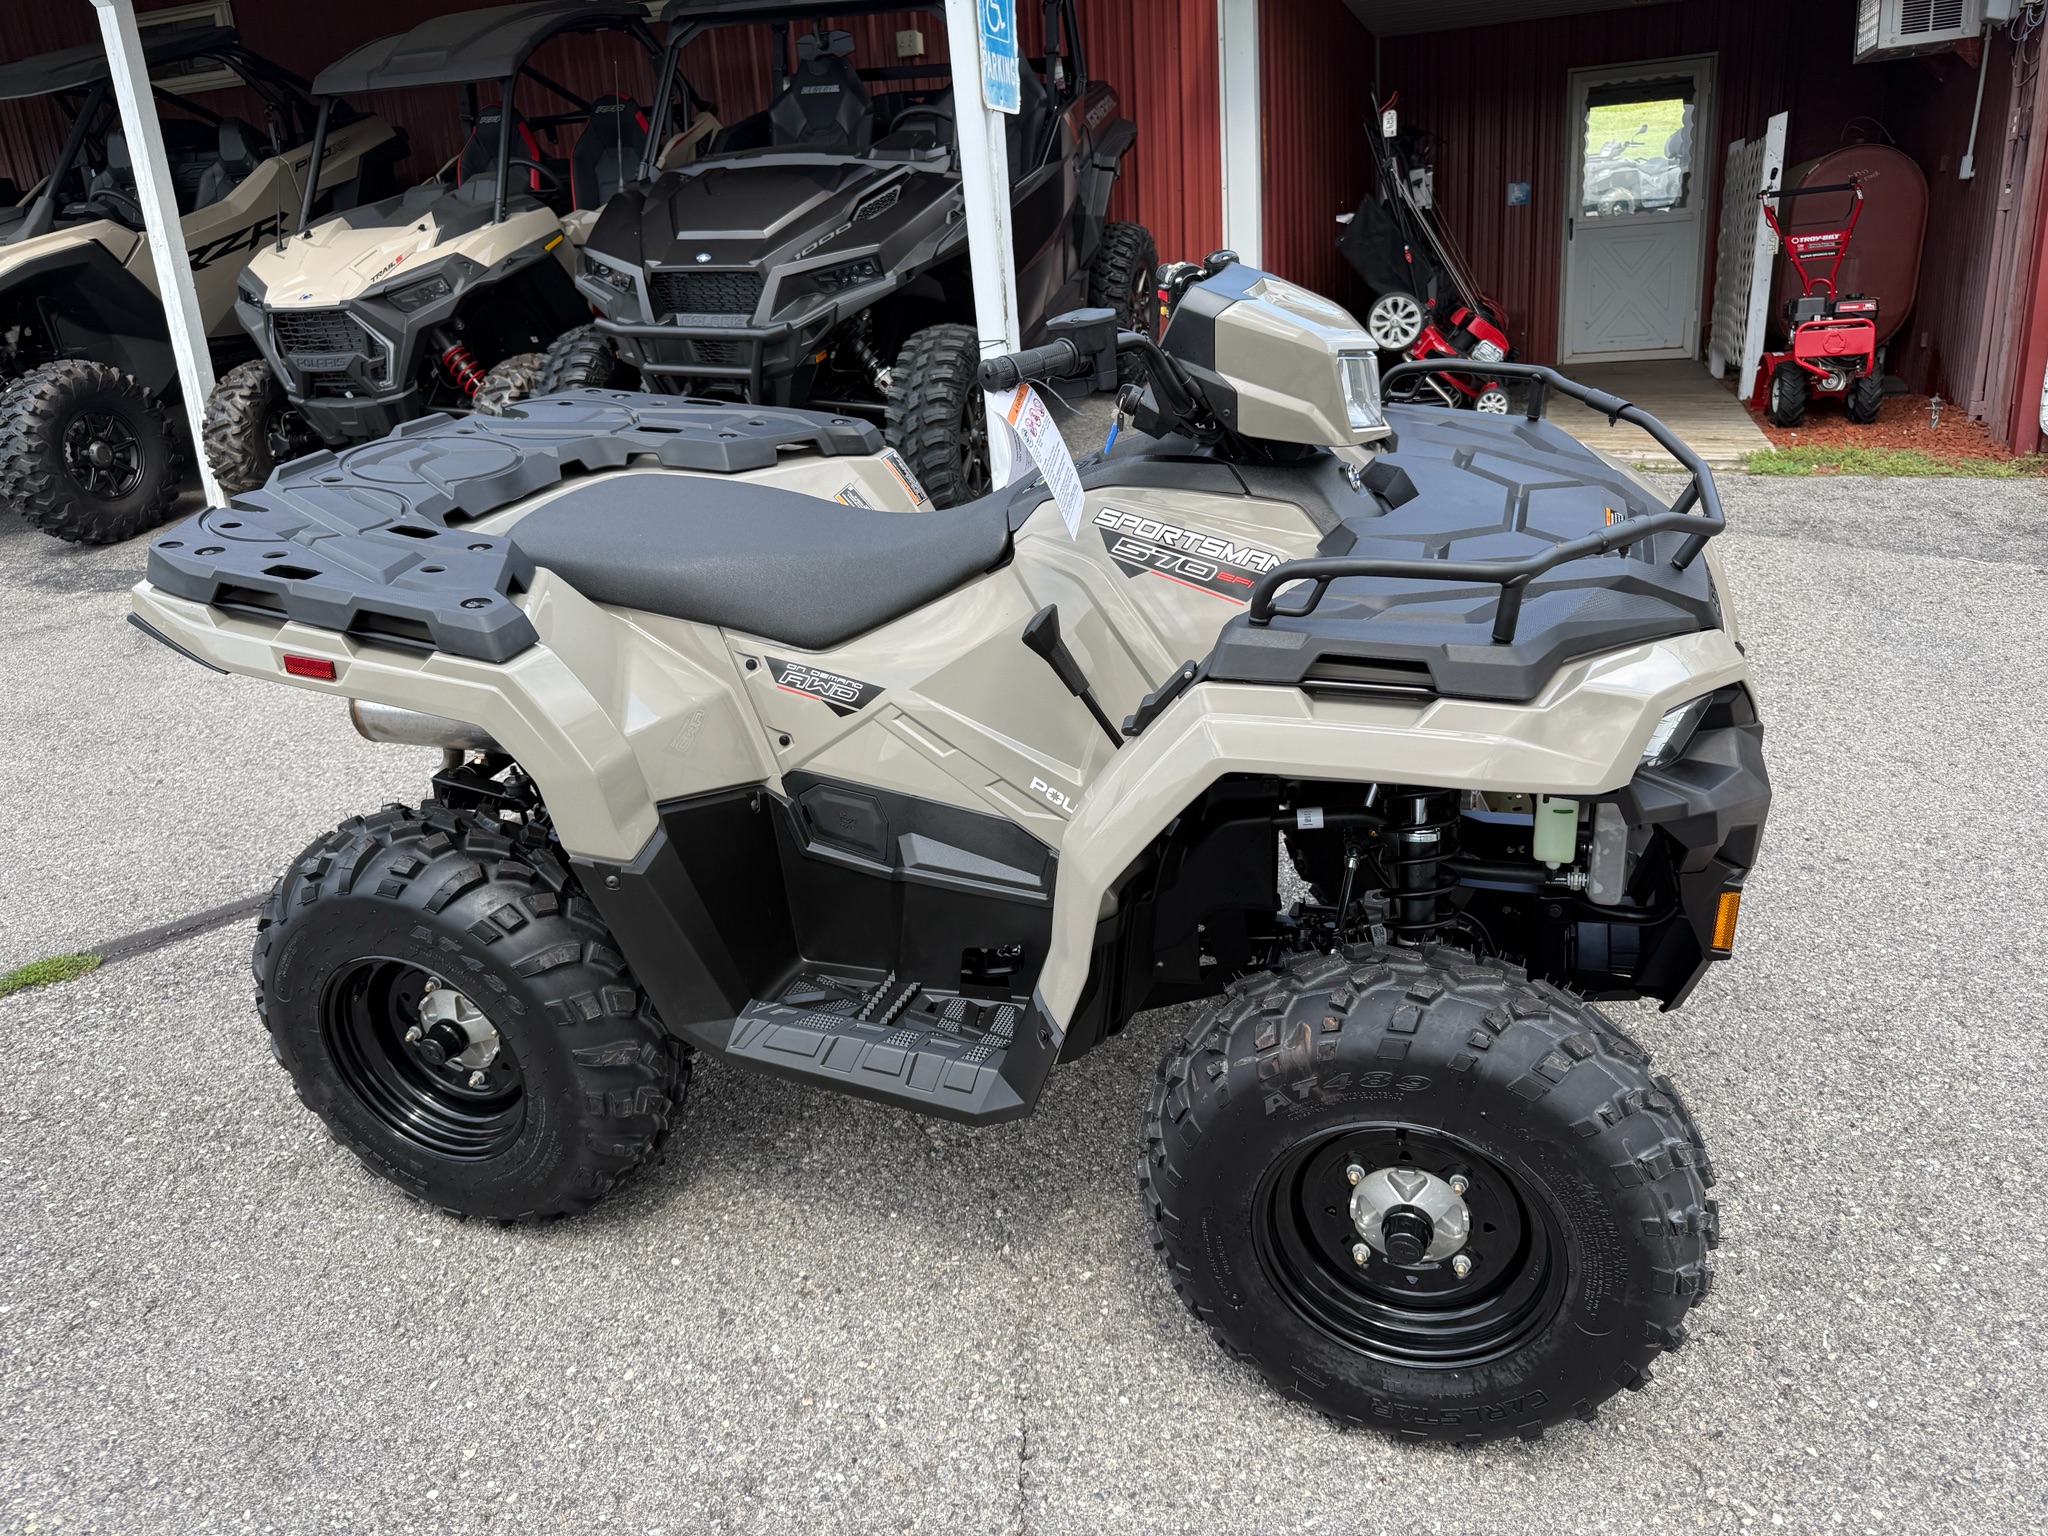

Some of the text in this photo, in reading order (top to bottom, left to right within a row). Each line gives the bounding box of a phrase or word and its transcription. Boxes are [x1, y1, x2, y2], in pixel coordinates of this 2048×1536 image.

[982, 50, 1019, 87] PARKING
[295, 147, 331, 173] PO
[794, 222, 852, 261] 1000
[370, 261, 396, 283] TRAIL
[681, 315, 745, 327] POLARIS
[297, 357, 346, 368] POLARIS
[1111, 537, 1255, 588] 570 EFI
[779, 670, 859, 702] AWD
[786, 663, 864, 689] ON DEMAND
[1264, 1071, 1433, 1116] AT489
[1370, 1389, 1550, 1426] CARLSTAR
